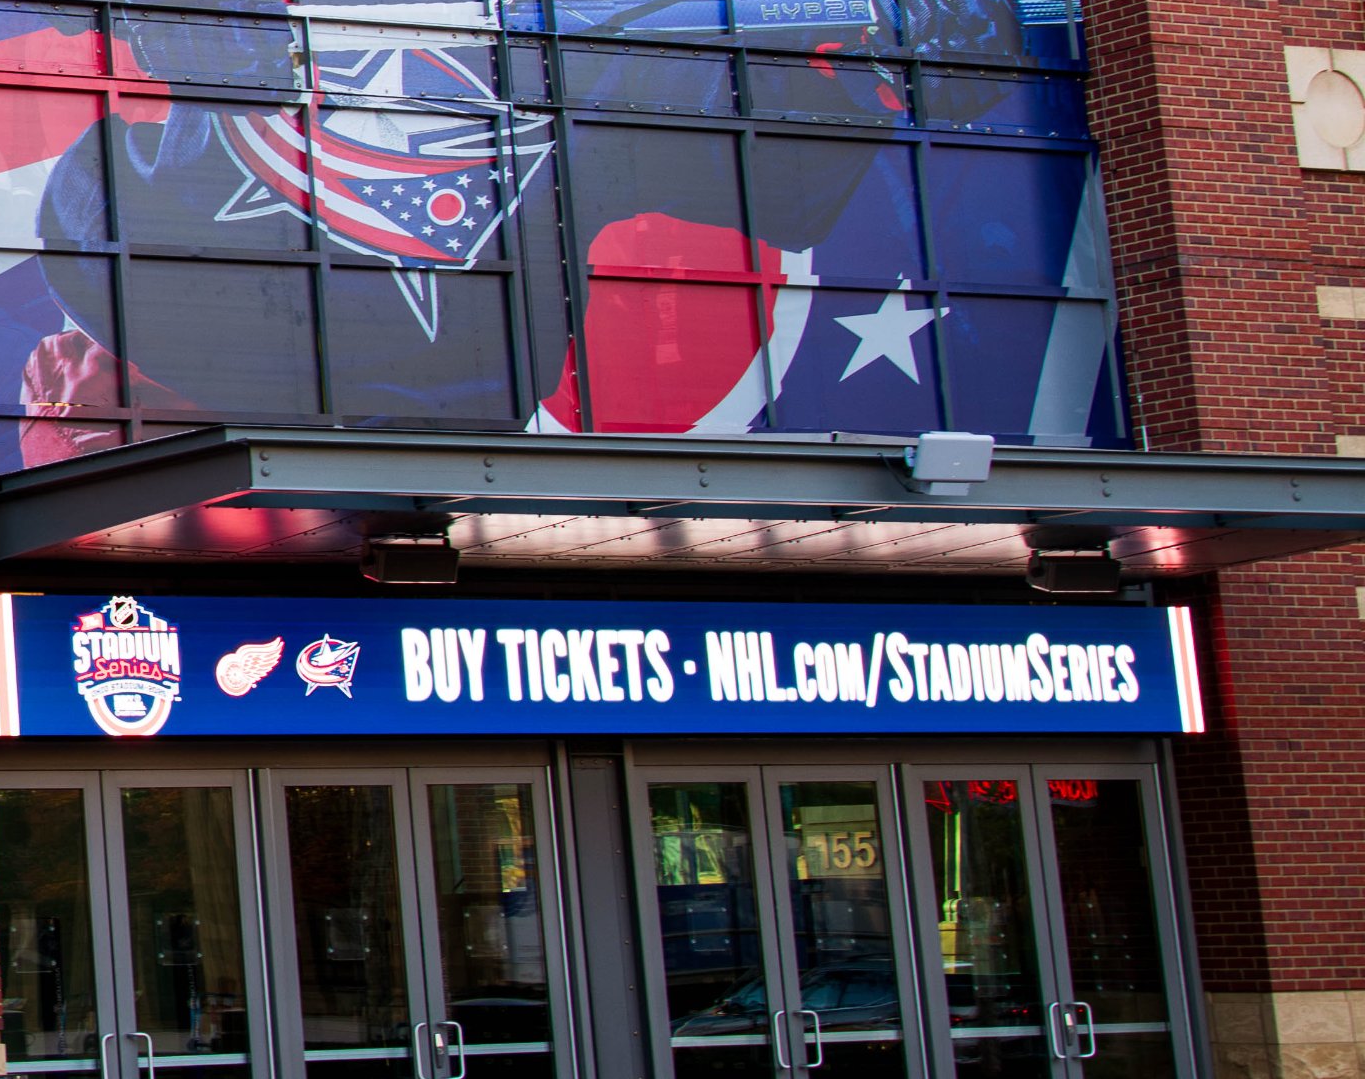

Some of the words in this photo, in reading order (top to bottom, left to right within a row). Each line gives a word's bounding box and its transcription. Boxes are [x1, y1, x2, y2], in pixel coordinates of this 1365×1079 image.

[72, 631, 181, 676] STADIUM
[94, 656, 164, 681] Series
[400, 627, 486, 702] BUY
[495, 627, 675, 703] TICKETS
[806, 831, 877, 870] 155
